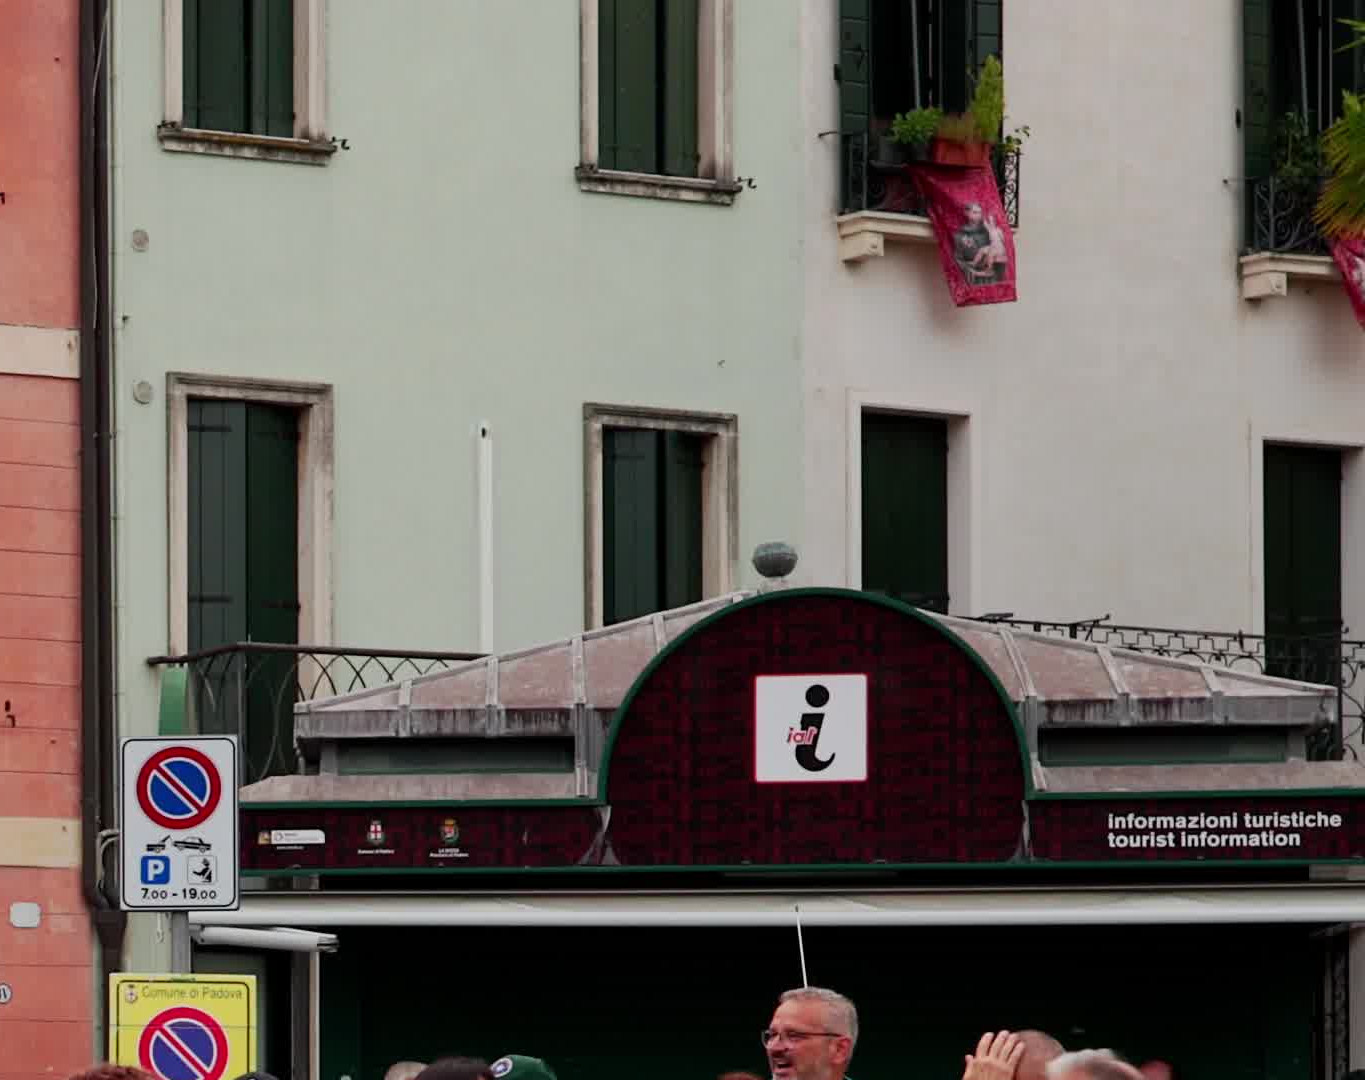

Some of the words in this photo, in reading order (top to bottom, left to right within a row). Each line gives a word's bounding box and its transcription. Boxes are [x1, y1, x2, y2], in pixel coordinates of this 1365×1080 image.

[1107, 812, 1238, 829] informazioni
[1244, 811, 1342, 828] turistiche
[1107, 831, 1175, 848] tourist
[1180, 830, 1301, 847] information
[147, 859, 165, 882] P
[141, 985, 186, 999] Comune
[189, 985, 198, 999] di
[202, 985, 243, 999] Padova
